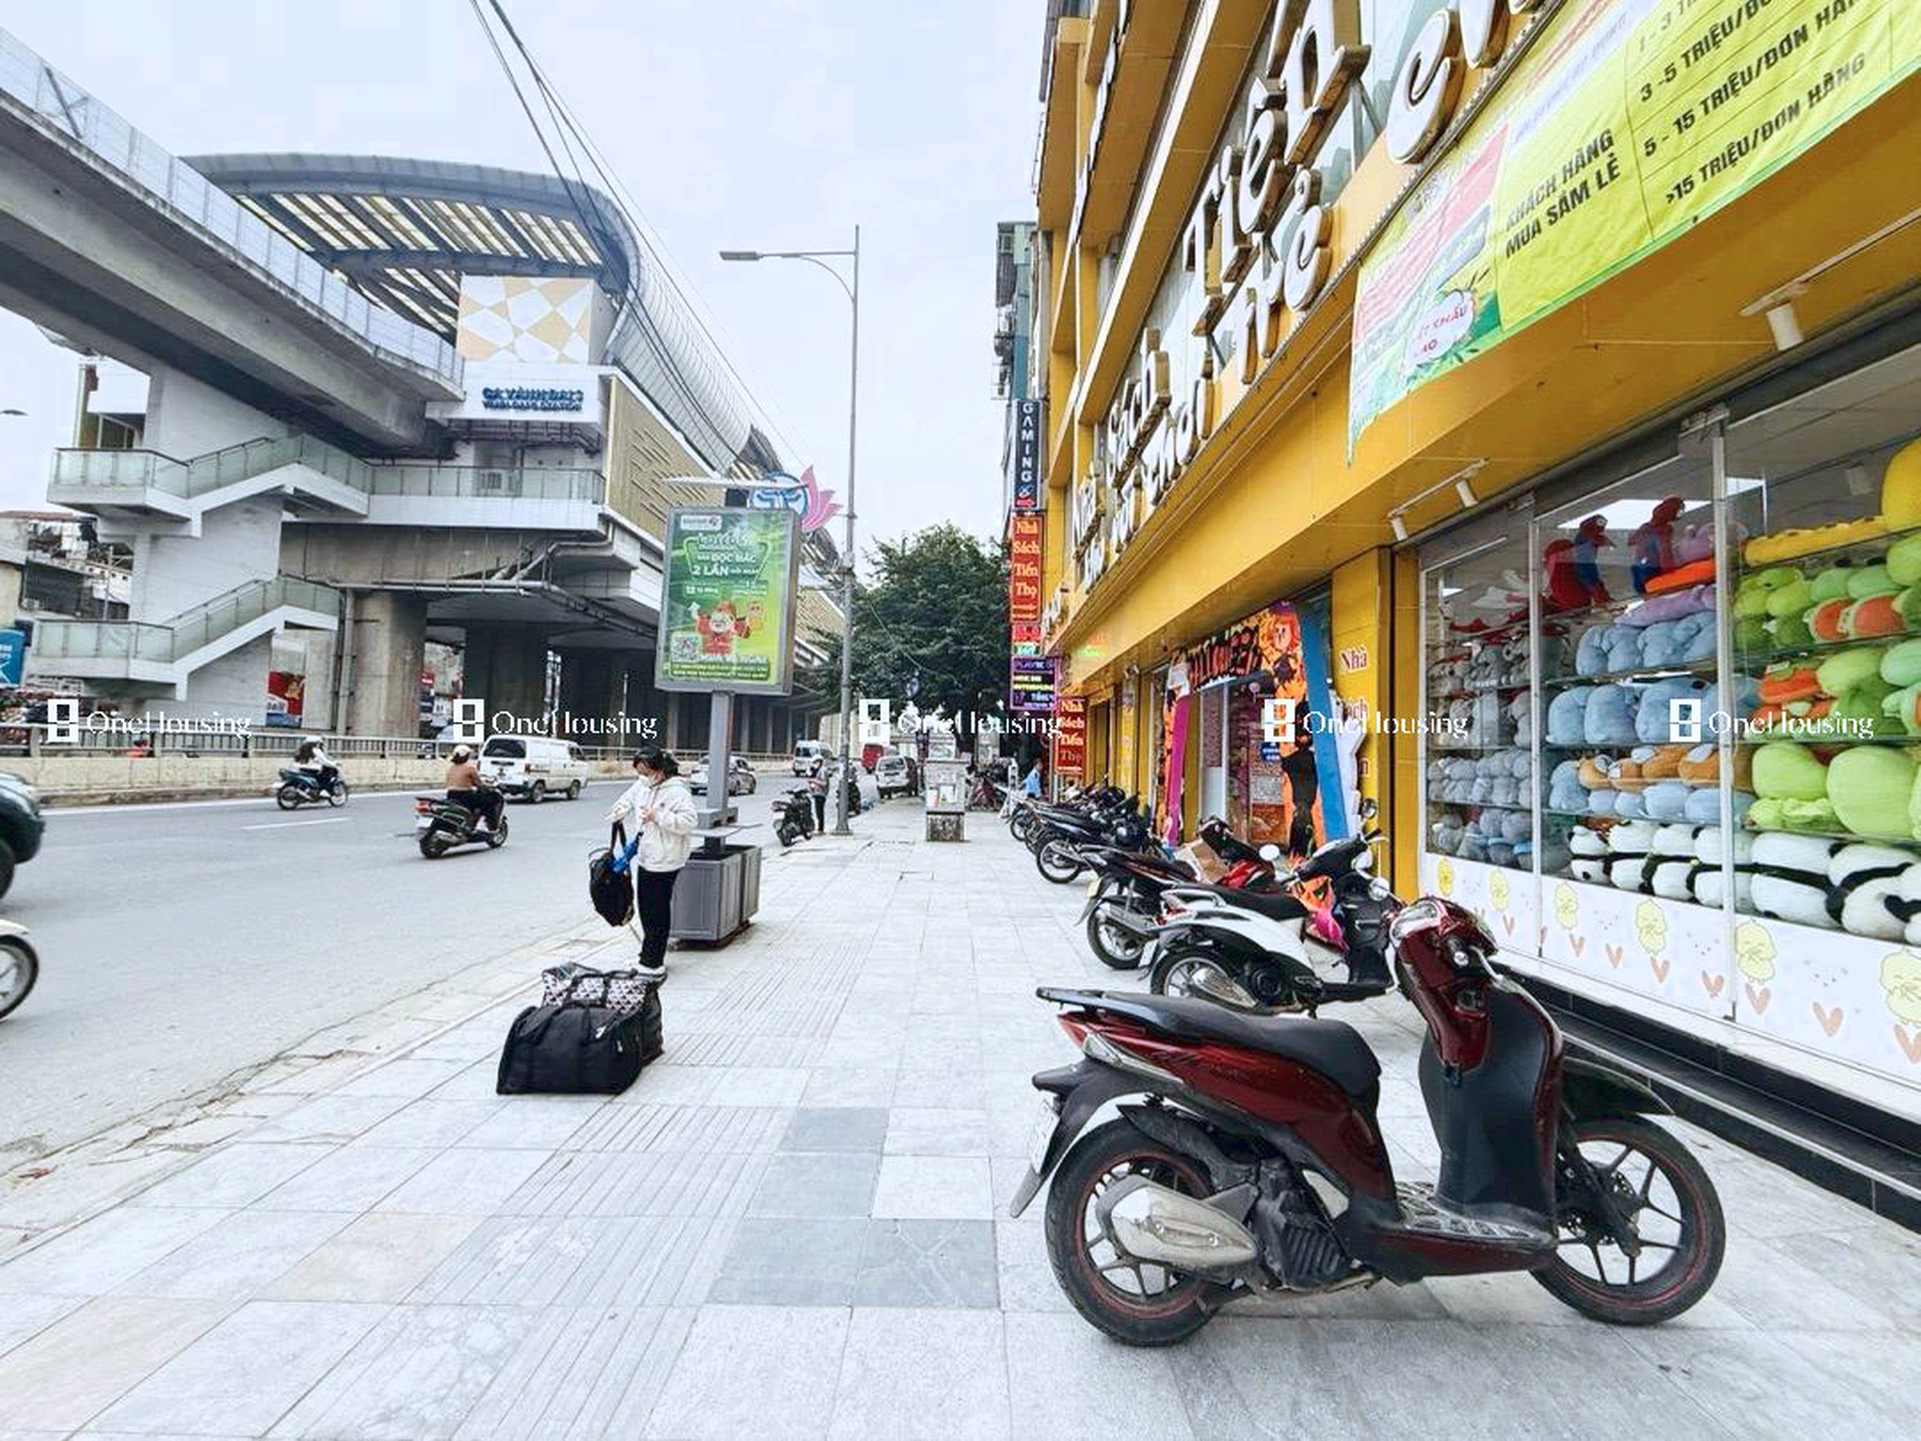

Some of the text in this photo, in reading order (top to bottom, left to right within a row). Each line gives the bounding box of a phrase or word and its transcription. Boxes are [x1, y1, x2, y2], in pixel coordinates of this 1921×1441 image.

[1640, 83, 1652, 102] 3
[1644, 138, 1657, 157] 5
[1672, 109, 1696, 135] 15
[1665, 175, 1695, 204] >15
[1806, 53, 1866, 110] HÀNG
[1505, 128, 1615, 232] KHÁCH HÀNG
[1505, 217, 1542, 259] MUA
[1595, 152, 1621, 191] LẺ
[1020, 402, 1035, 483] GAMING
[1013, 540, 1041, 554] Sách
